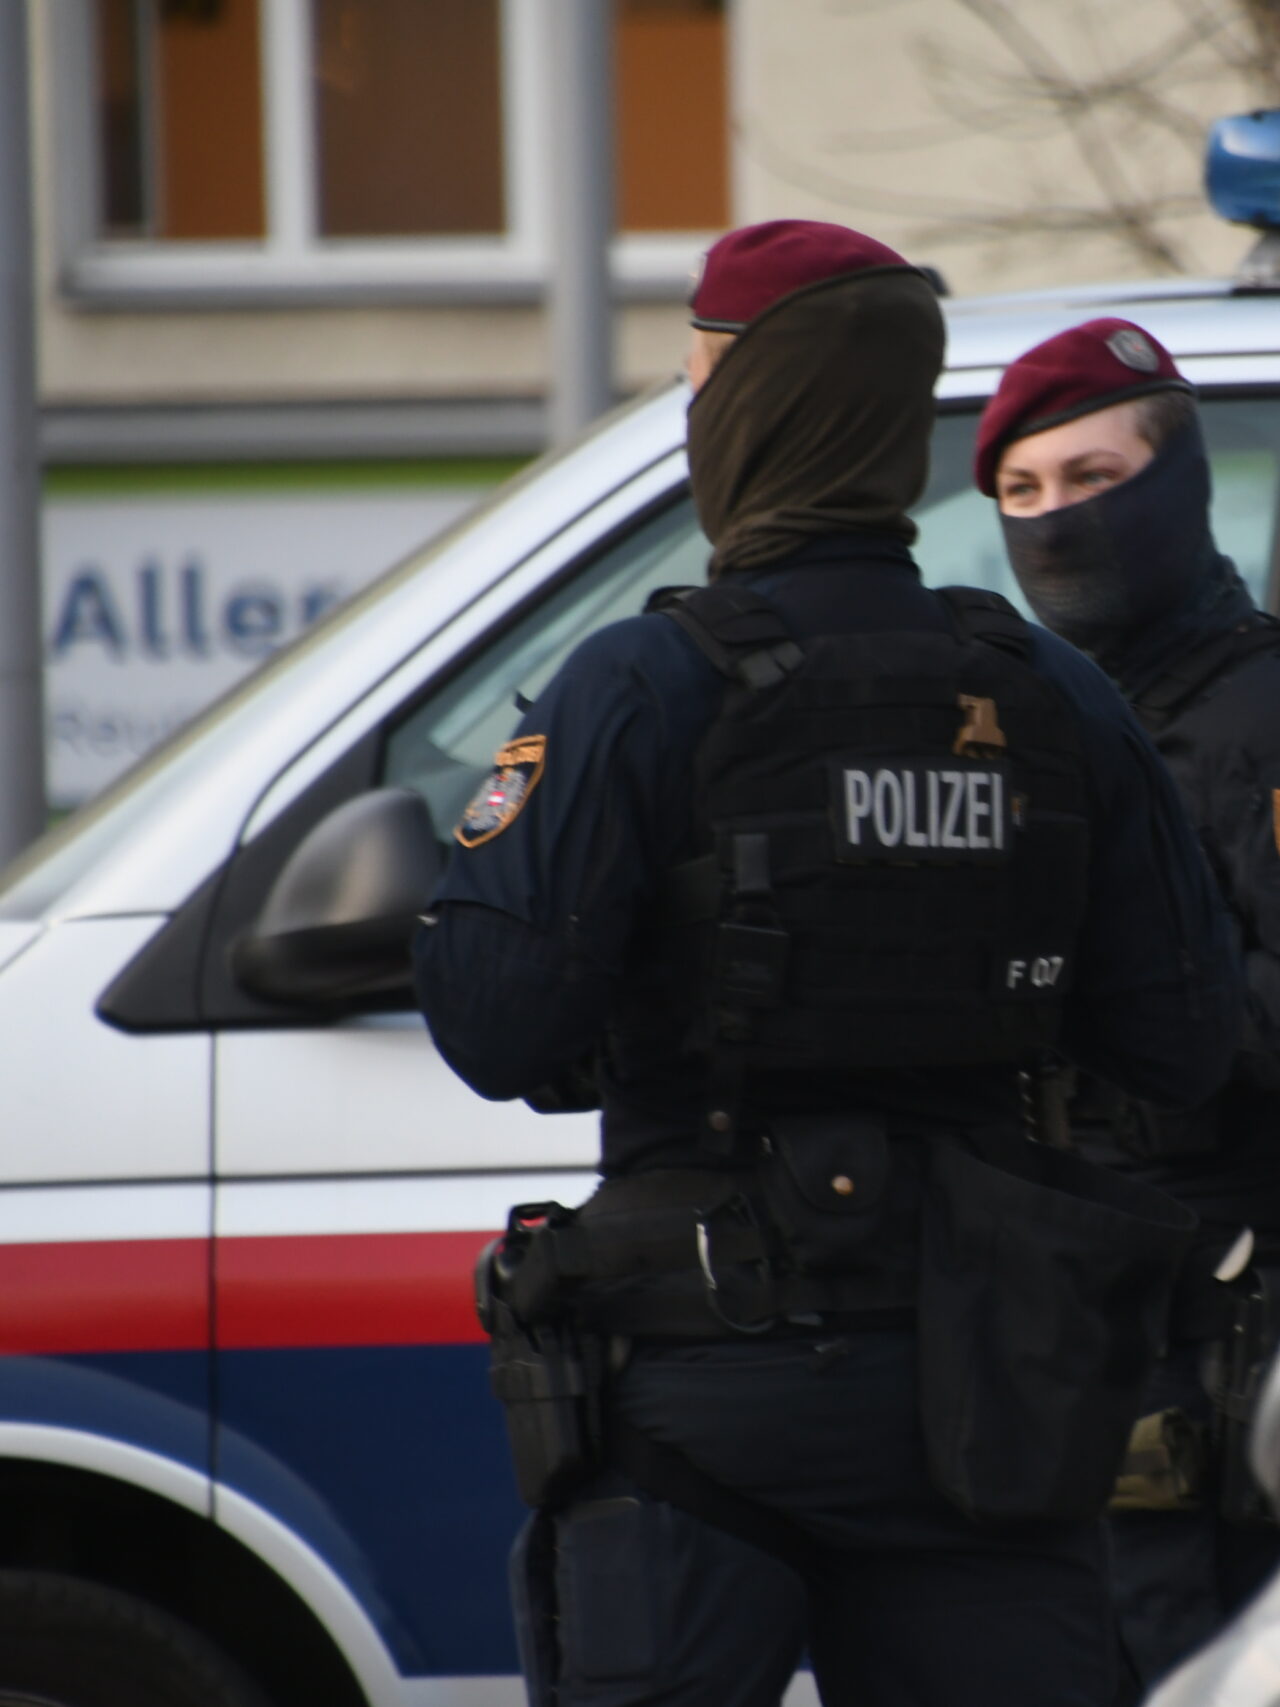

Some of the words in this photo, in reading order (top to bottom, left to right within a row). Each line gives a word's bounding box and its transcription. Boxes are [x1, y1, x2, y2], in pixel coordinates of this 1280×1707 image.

[844, 769, 1004, 849] POLIZEI
[1007, 960, 1026, 989] F
[1031, 956, 1064, 987] 07
